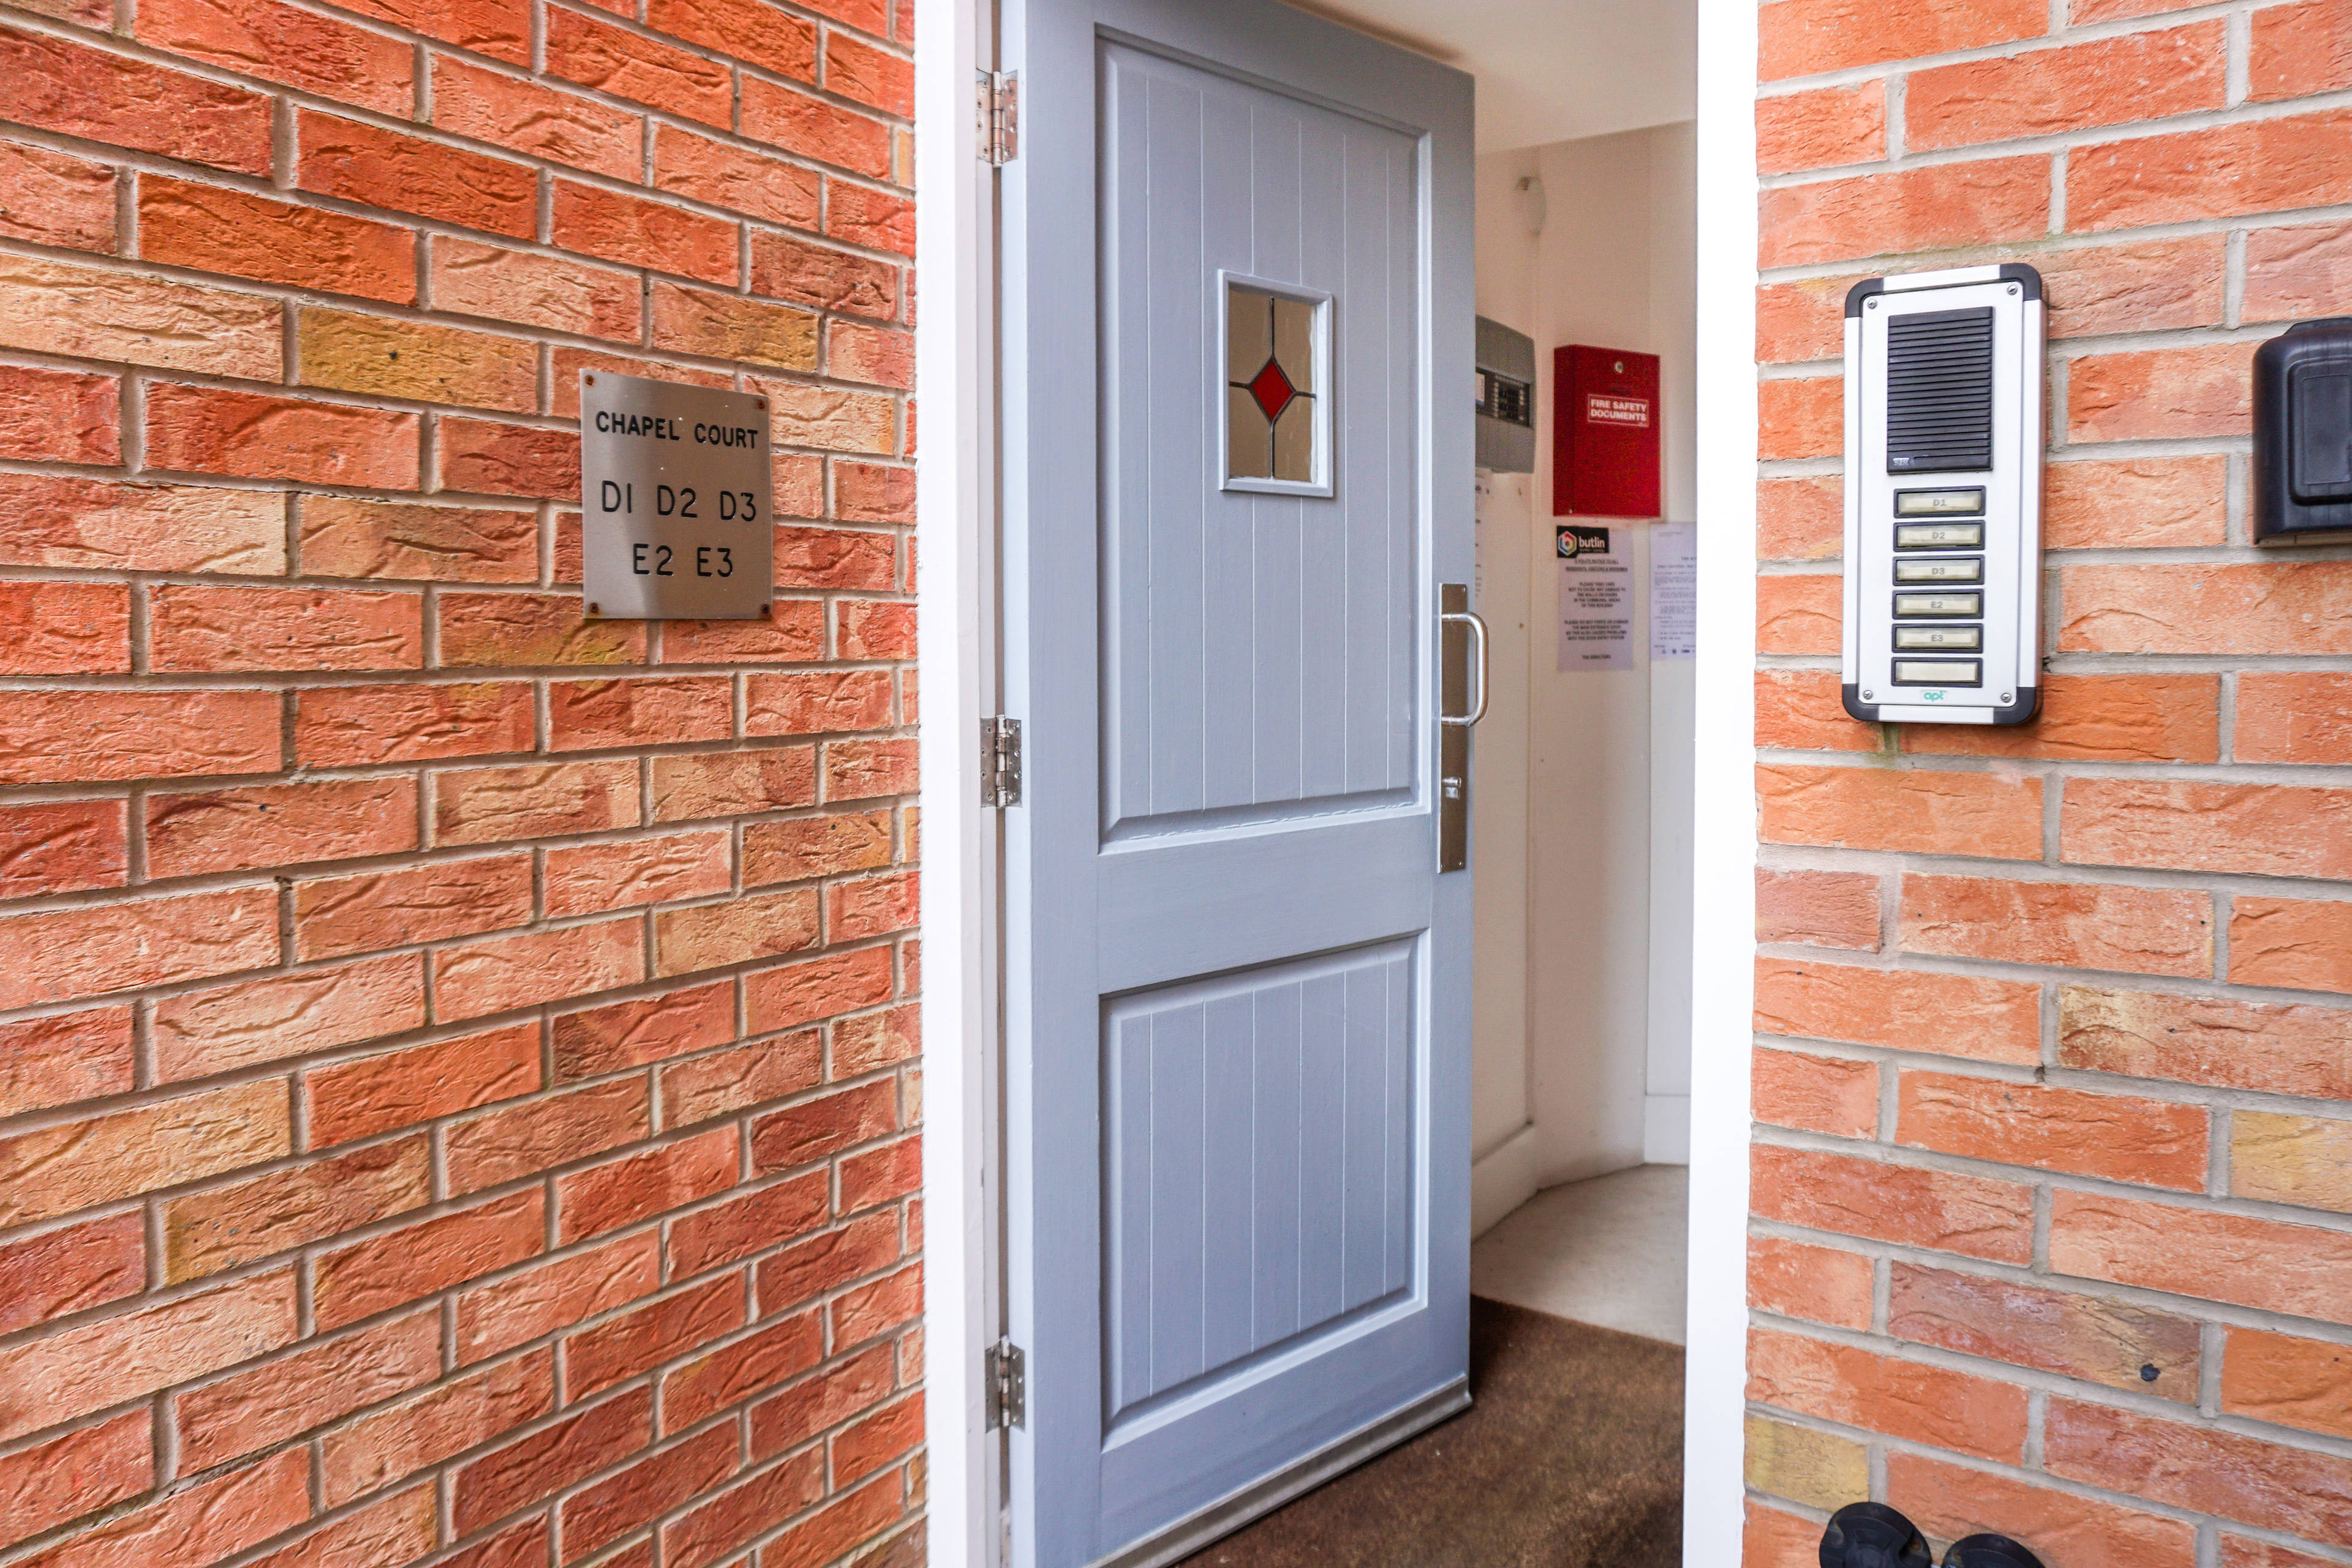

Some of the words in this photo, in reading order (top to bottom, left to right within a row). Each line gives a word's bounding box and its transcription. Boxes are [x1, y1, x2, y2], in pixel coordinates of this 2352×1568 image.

[1591, 399, 1610, 409] FIRE
[1613, 401, 1647, 412] SAFETY
[1591, 409, 1647, 421] DOCUMENTS
[595, 410, 680, 441] CHAPEL
[694, 423, 758, 449] COURT
[657, 484, 698, 518] D2
[720, 491, 756, 522] D3
[1579, 536, 1605, 548] butlin
[1932, 531, 1946, 540] D2
[633, 543, 674, 576] E2
[697, 546, 733, 578] E3
